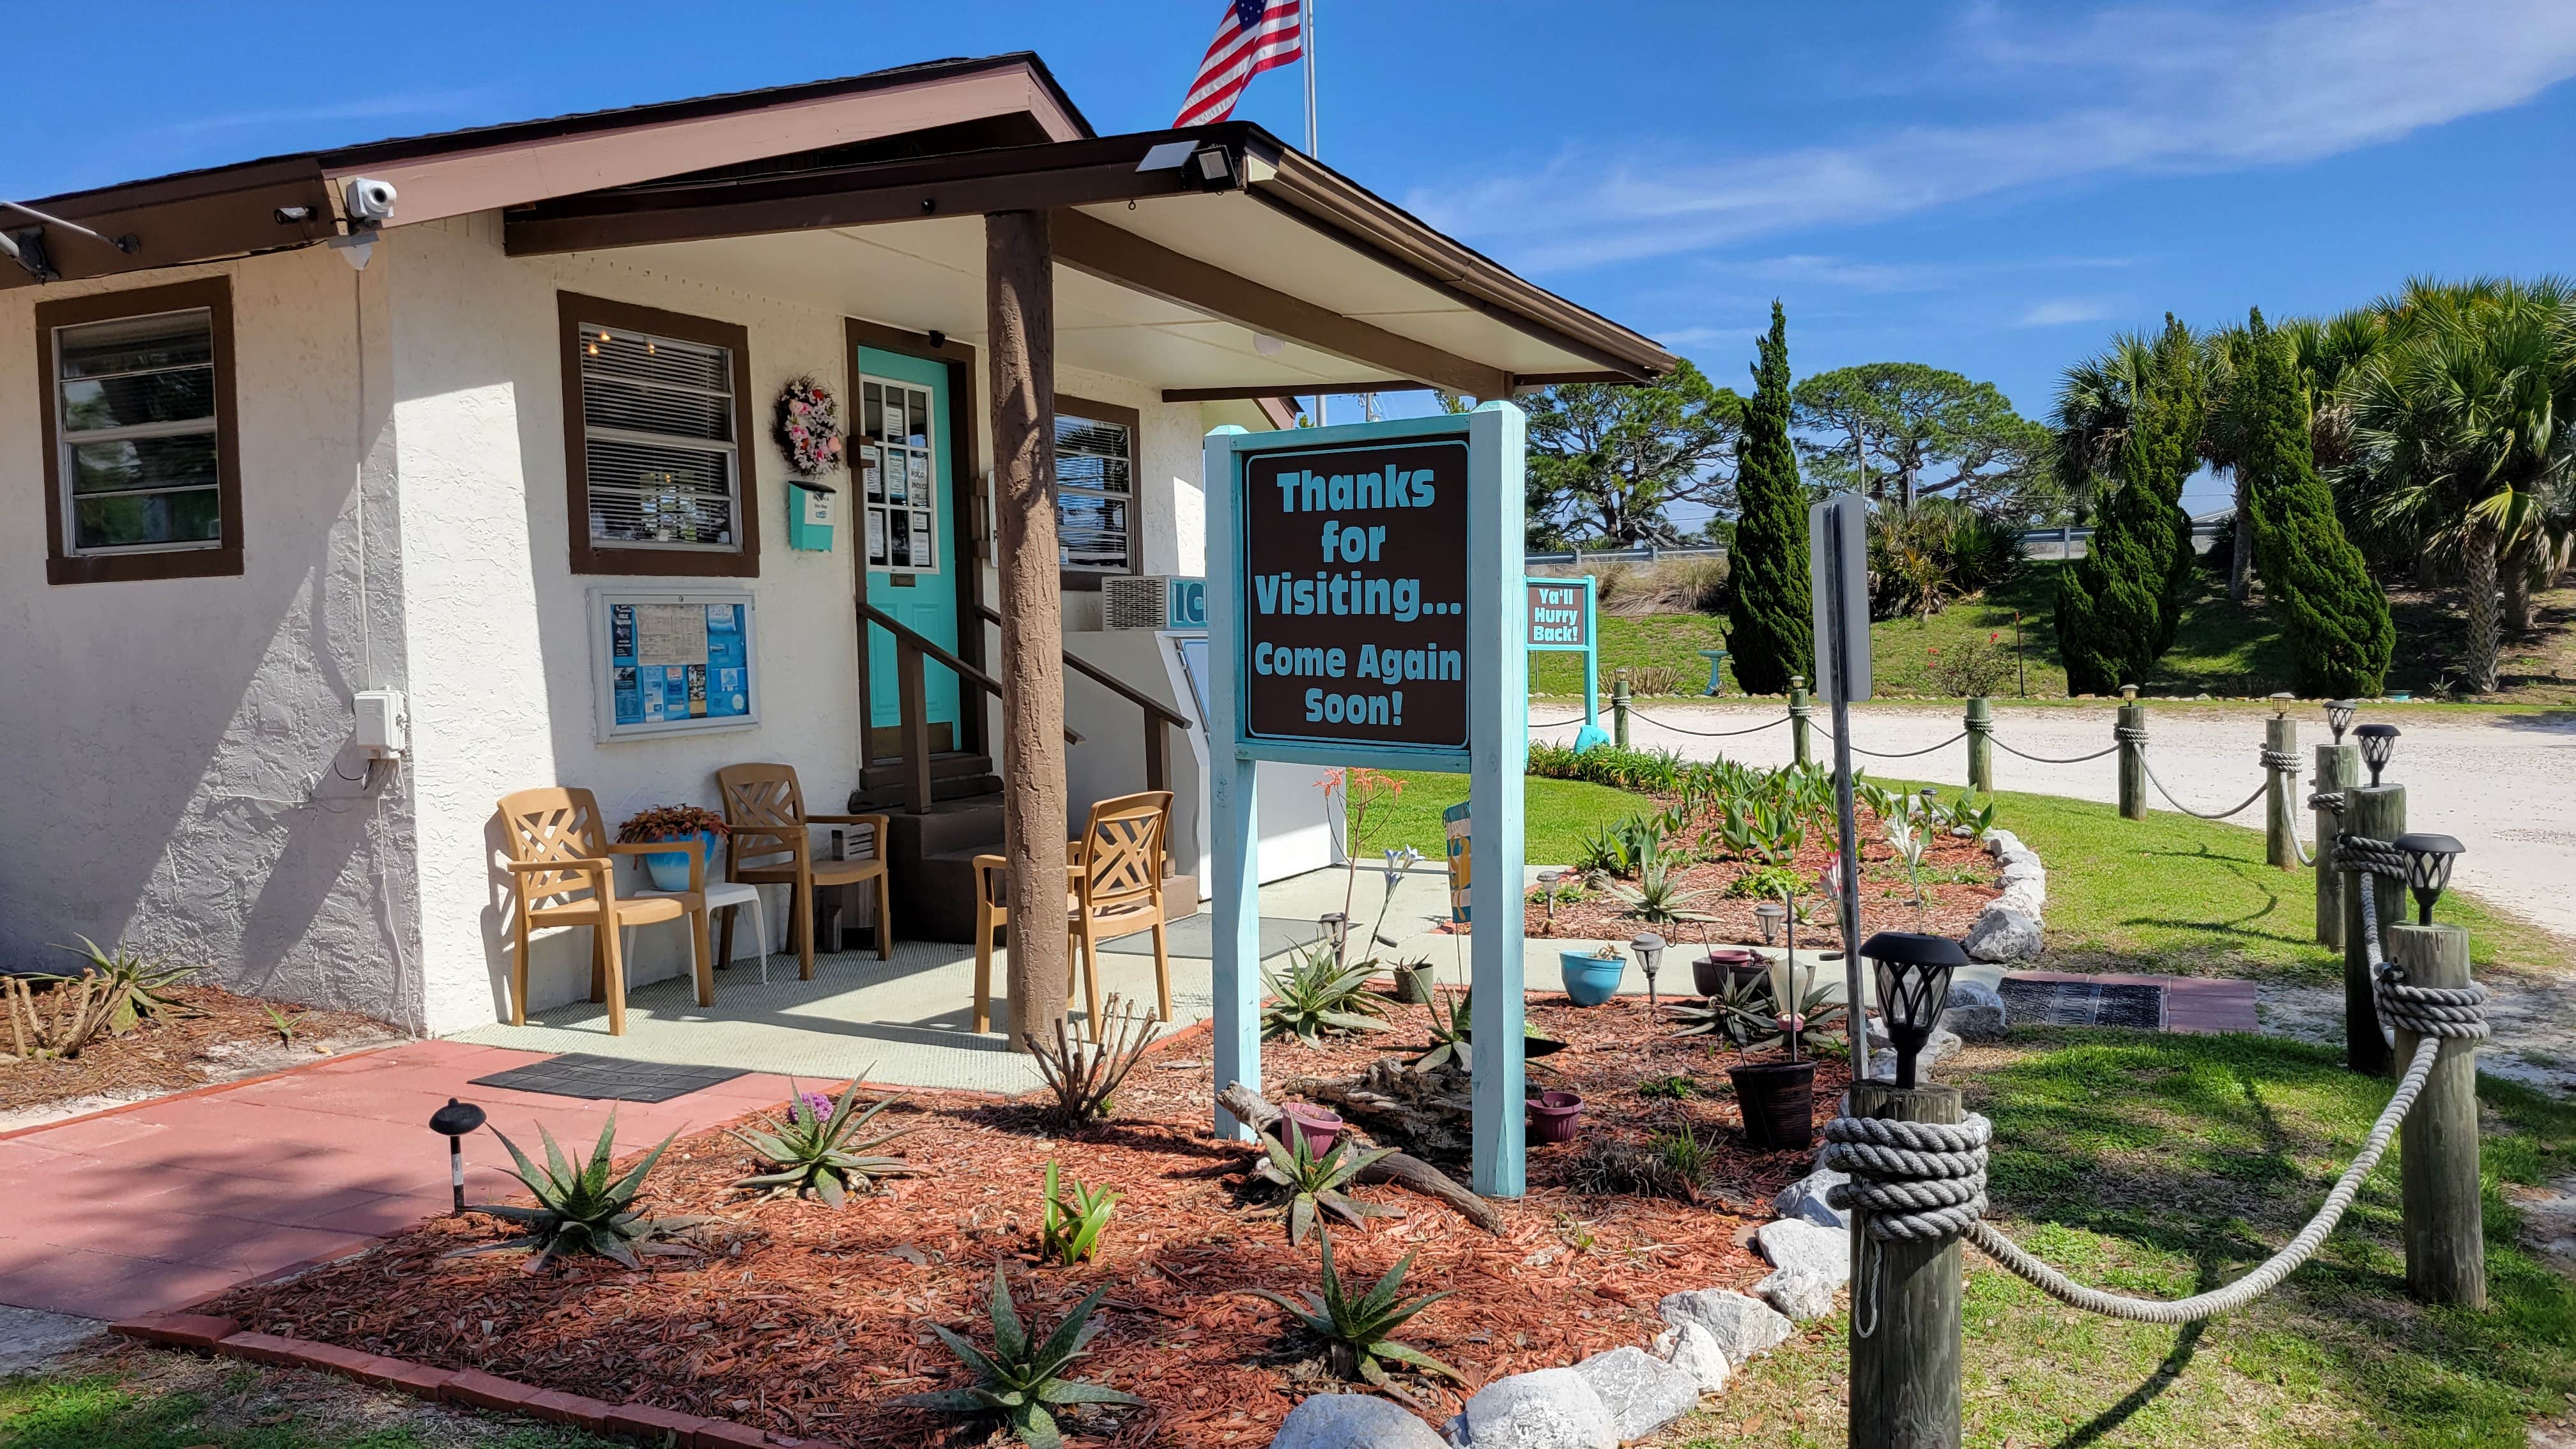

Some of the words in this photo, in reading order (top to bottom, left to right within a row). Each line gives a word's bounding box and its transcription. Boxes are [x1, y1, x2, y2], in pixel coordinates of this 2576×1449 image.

[1277, 464, 1435, 512] Thanks
[1321, 521, 1386, 562] for
[1175, 582, 1208, 623] IC
[1254, 571, 1461, 622] Visiting...
[1535, 607, 1578, 626] Hurry
[1538, 588, 1574, 605] Ya'll
[1533, 625, 1578, 641] Back!
[1255, 641, 1346, 677] Come
[1357, 643, 1461, 684] Again
[1305, 687, 1403, 726] Soon!
